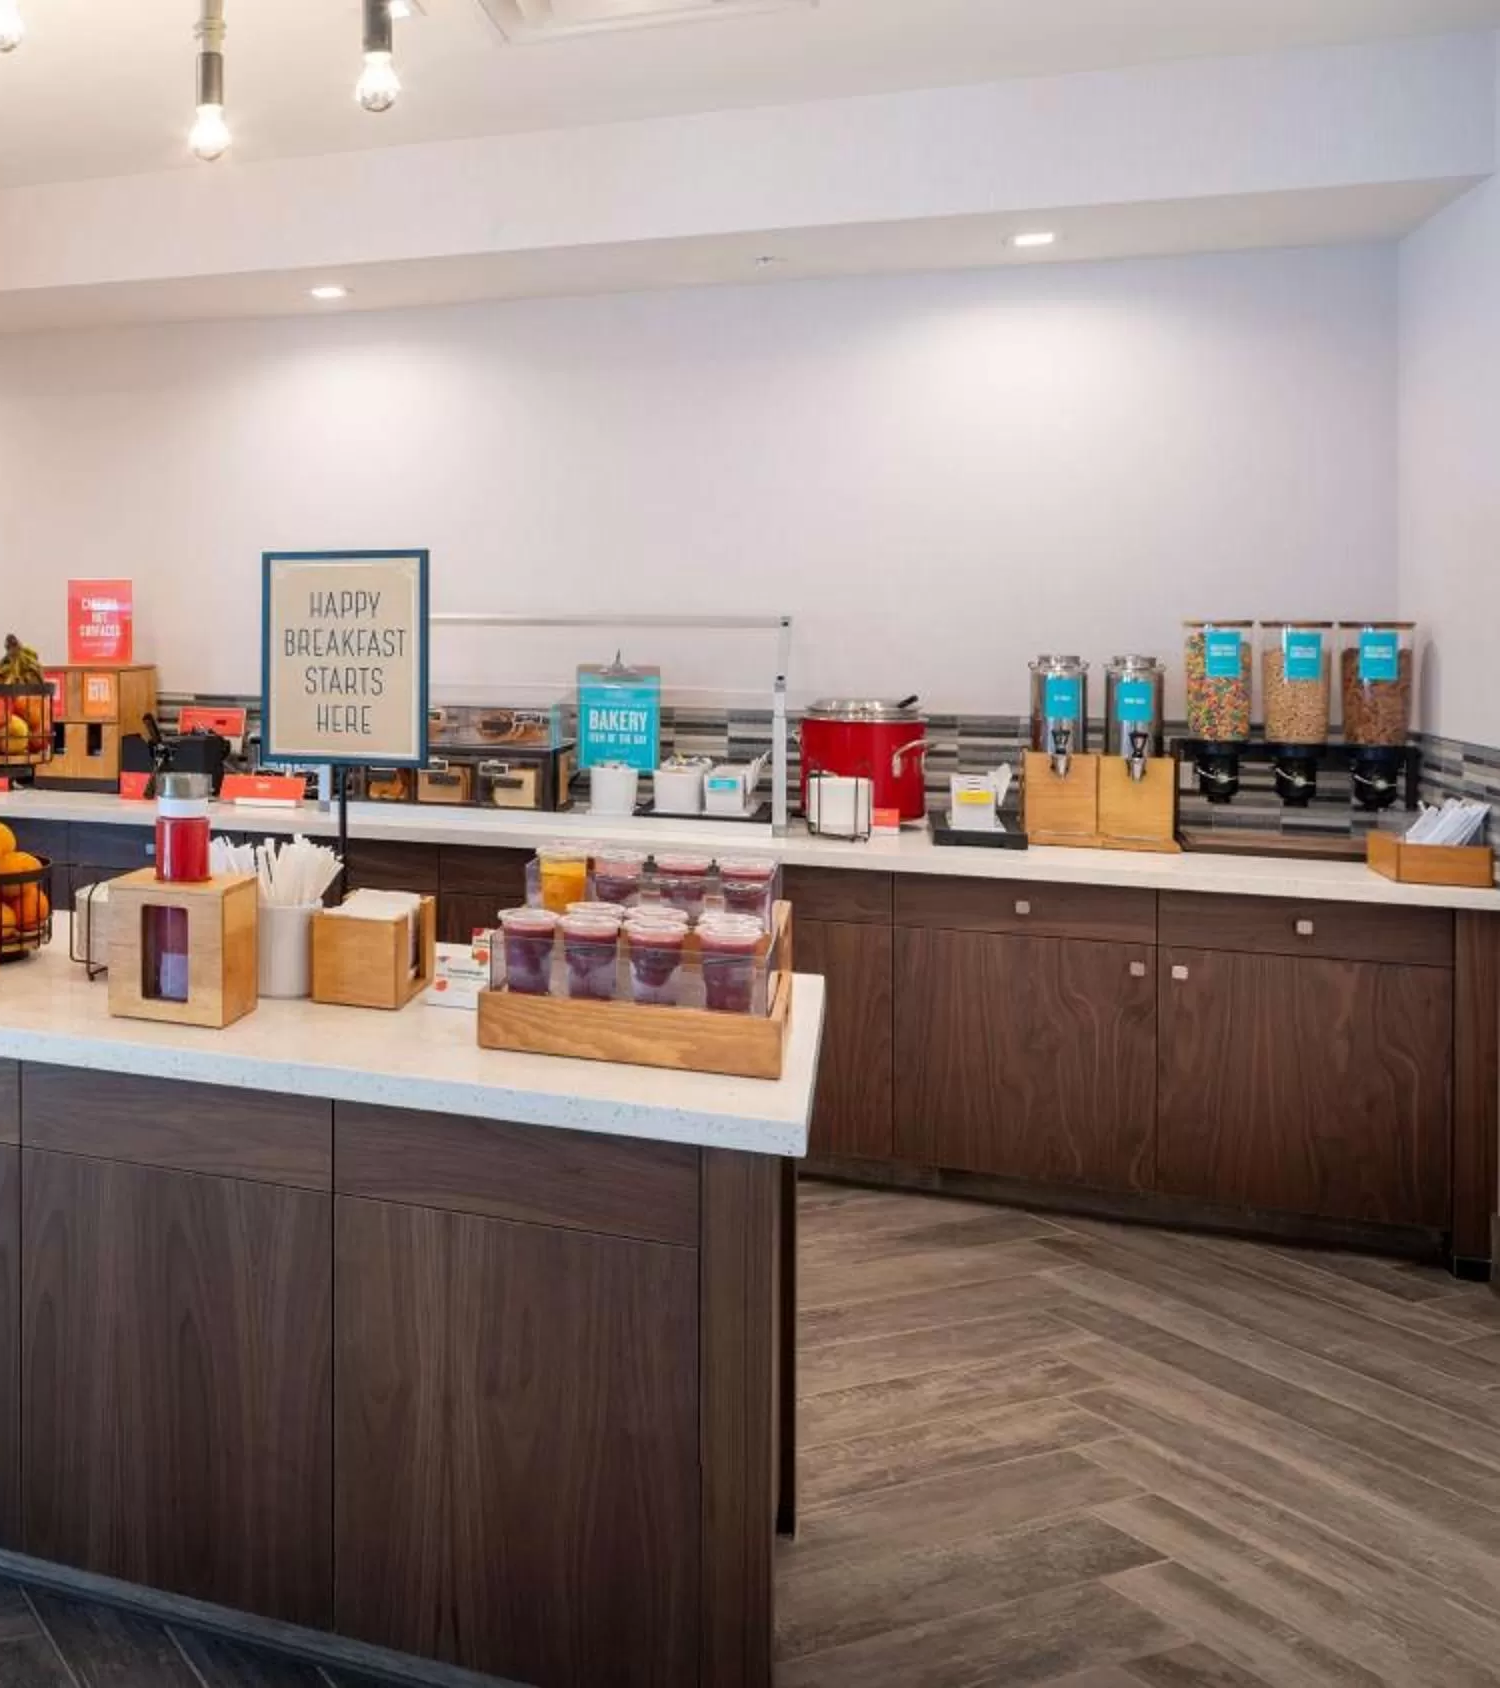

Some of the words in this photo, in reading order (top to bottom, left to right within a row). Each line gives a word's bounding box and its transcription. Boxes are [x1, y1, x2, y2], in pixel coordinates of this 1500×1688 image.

[309, 591, 381, 619] HAPPY
[284, 628, 406, 657] BREAKFAST
[304, 667, 384, 696] STARTS
[316, 704, 372, 734] HERE
[589, 709, 647, 732] BAKERY
